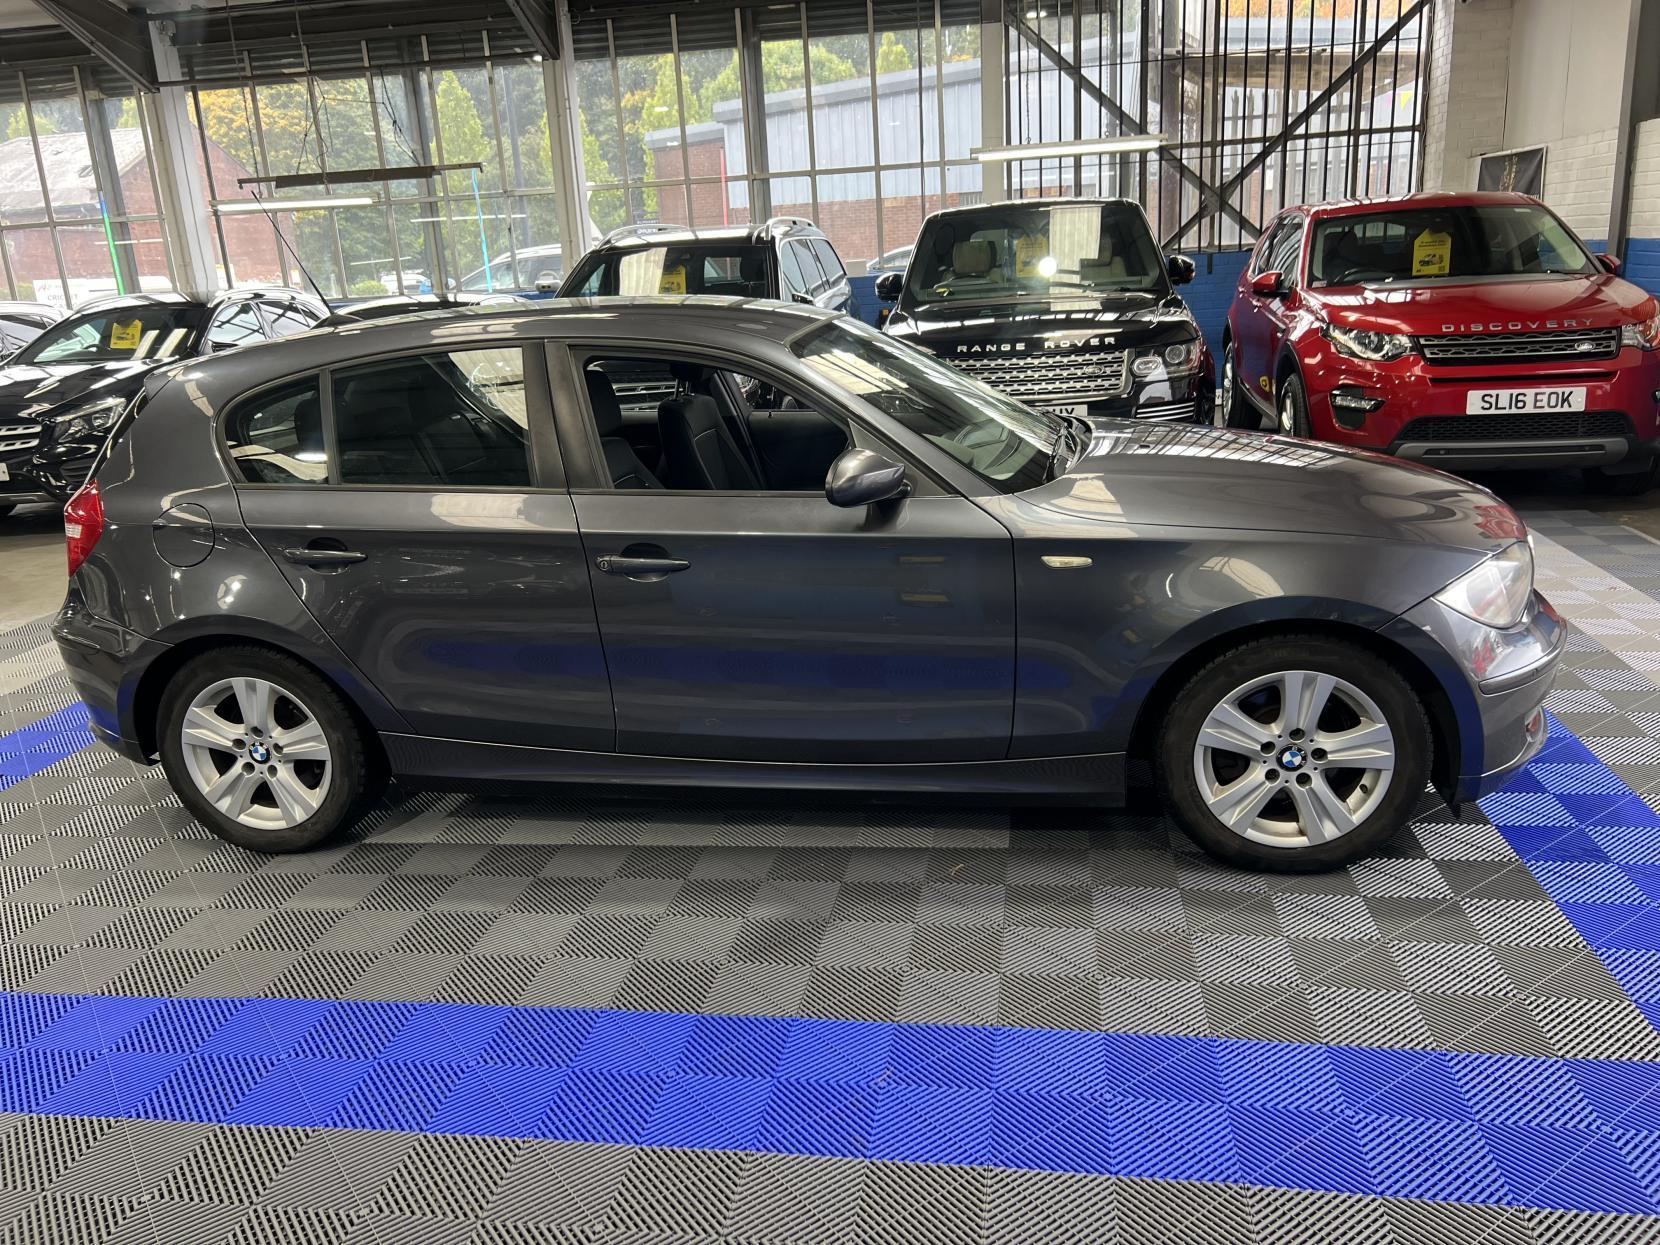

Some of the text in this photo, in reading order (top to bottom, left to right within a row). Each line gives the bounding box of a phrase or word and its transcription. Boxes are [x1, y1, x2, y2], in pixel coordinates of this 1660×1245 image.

[1441, 319, 1593, 332] DISCOVERY
[957, 337, 1116, 353] RANGE ROVER
[1480, 390, 1574, 411] SL16 EOK
